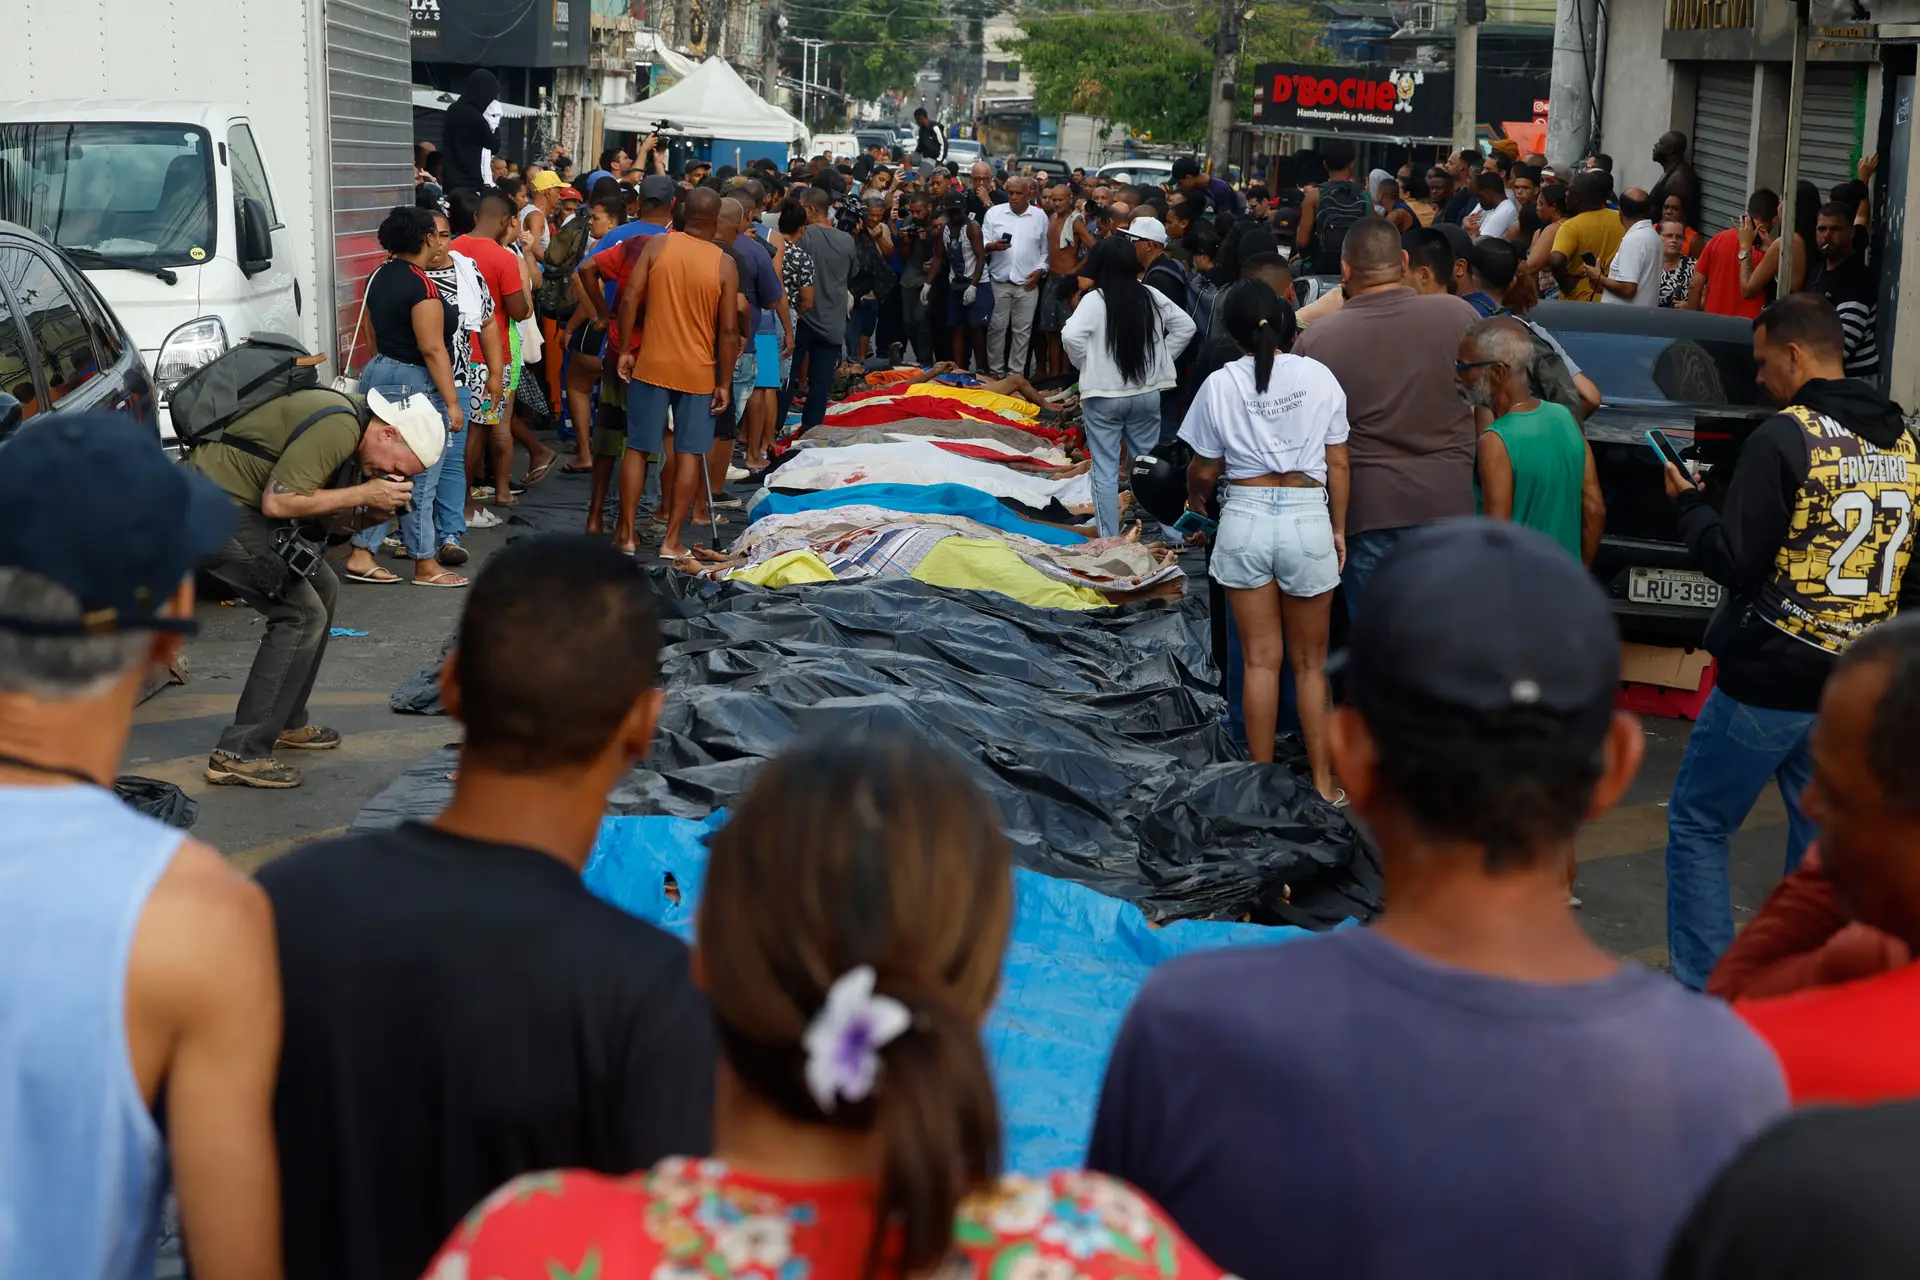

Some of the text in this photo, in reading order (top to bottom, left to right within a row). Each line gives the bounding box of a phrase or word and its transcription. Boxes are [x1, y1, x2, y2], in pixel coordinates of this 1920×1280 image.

[1297, 108, 1394, 124] Hamburgueria e Petiscaria
[1838, 454, 1909, 484] CRUZEIRO
[1825, 490, 1912, 596] 27
